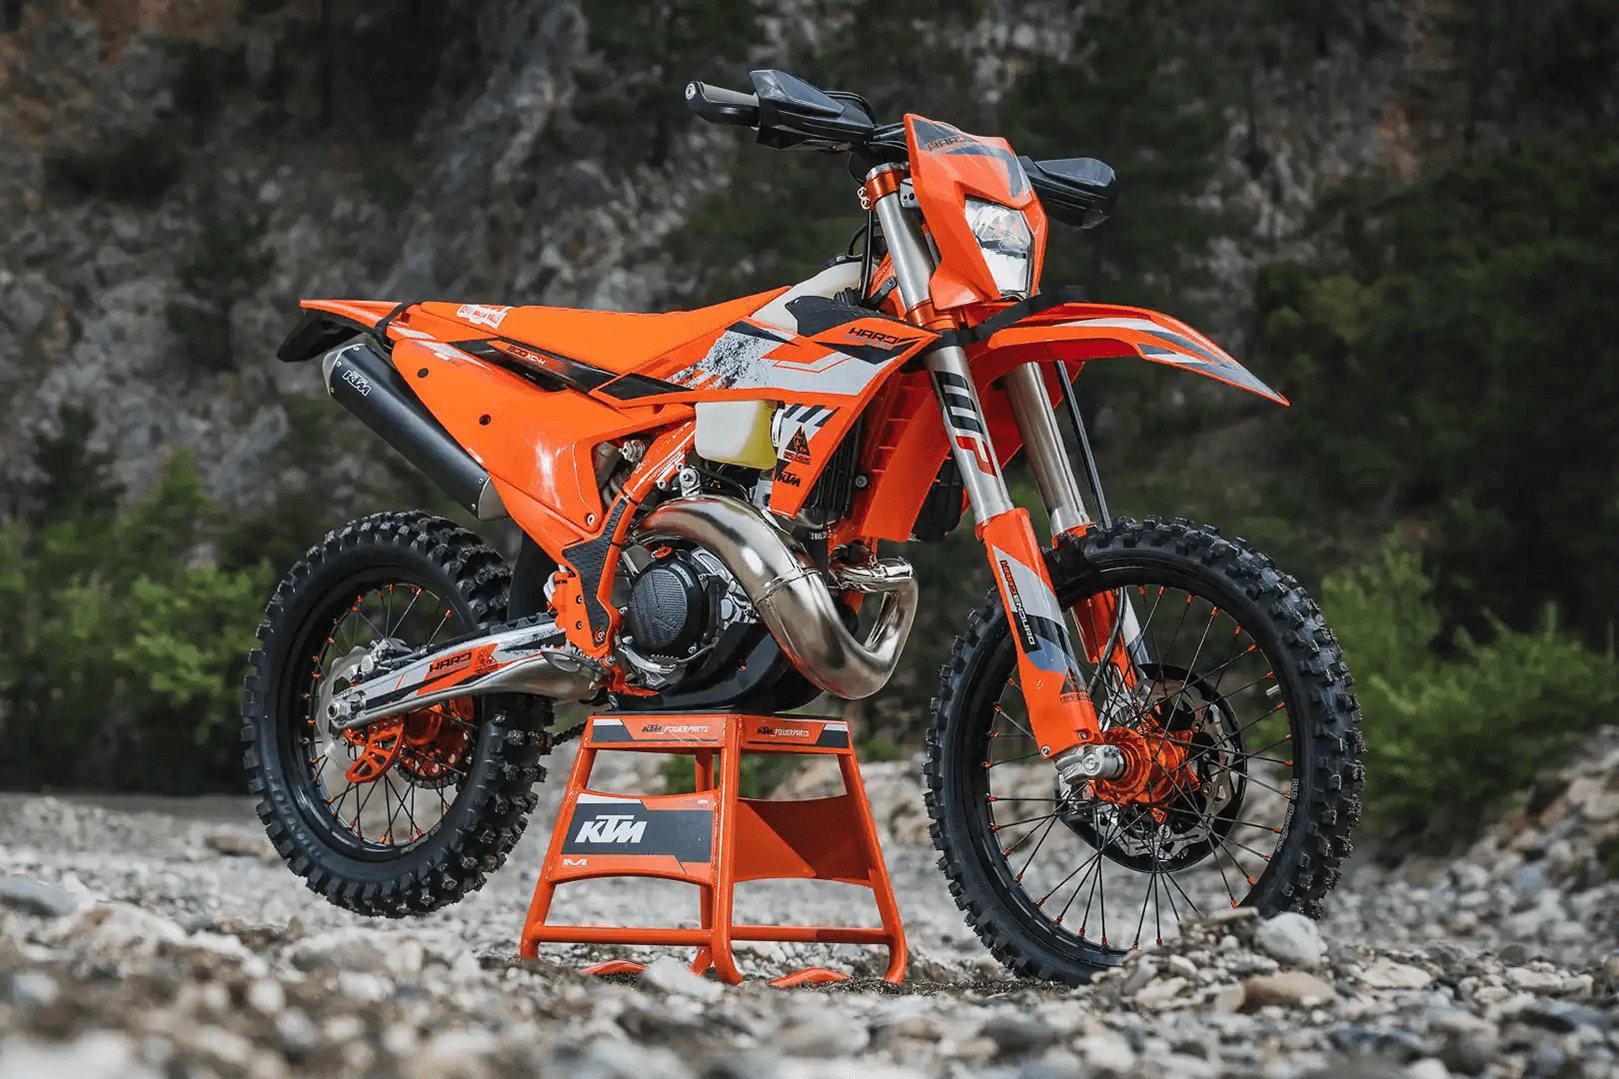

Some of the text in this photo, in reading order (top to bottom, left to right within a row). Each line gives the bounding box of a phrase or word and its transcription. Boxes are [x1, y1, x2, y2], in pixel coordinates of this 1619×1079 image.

[848, 327, 899, 345] HARD
[342, 370, 371, 396] KTM
[778, 471, 801, 487] KTM
[430, 652, 472, 672] HARD
[574, 815, 648, 843] KTM
